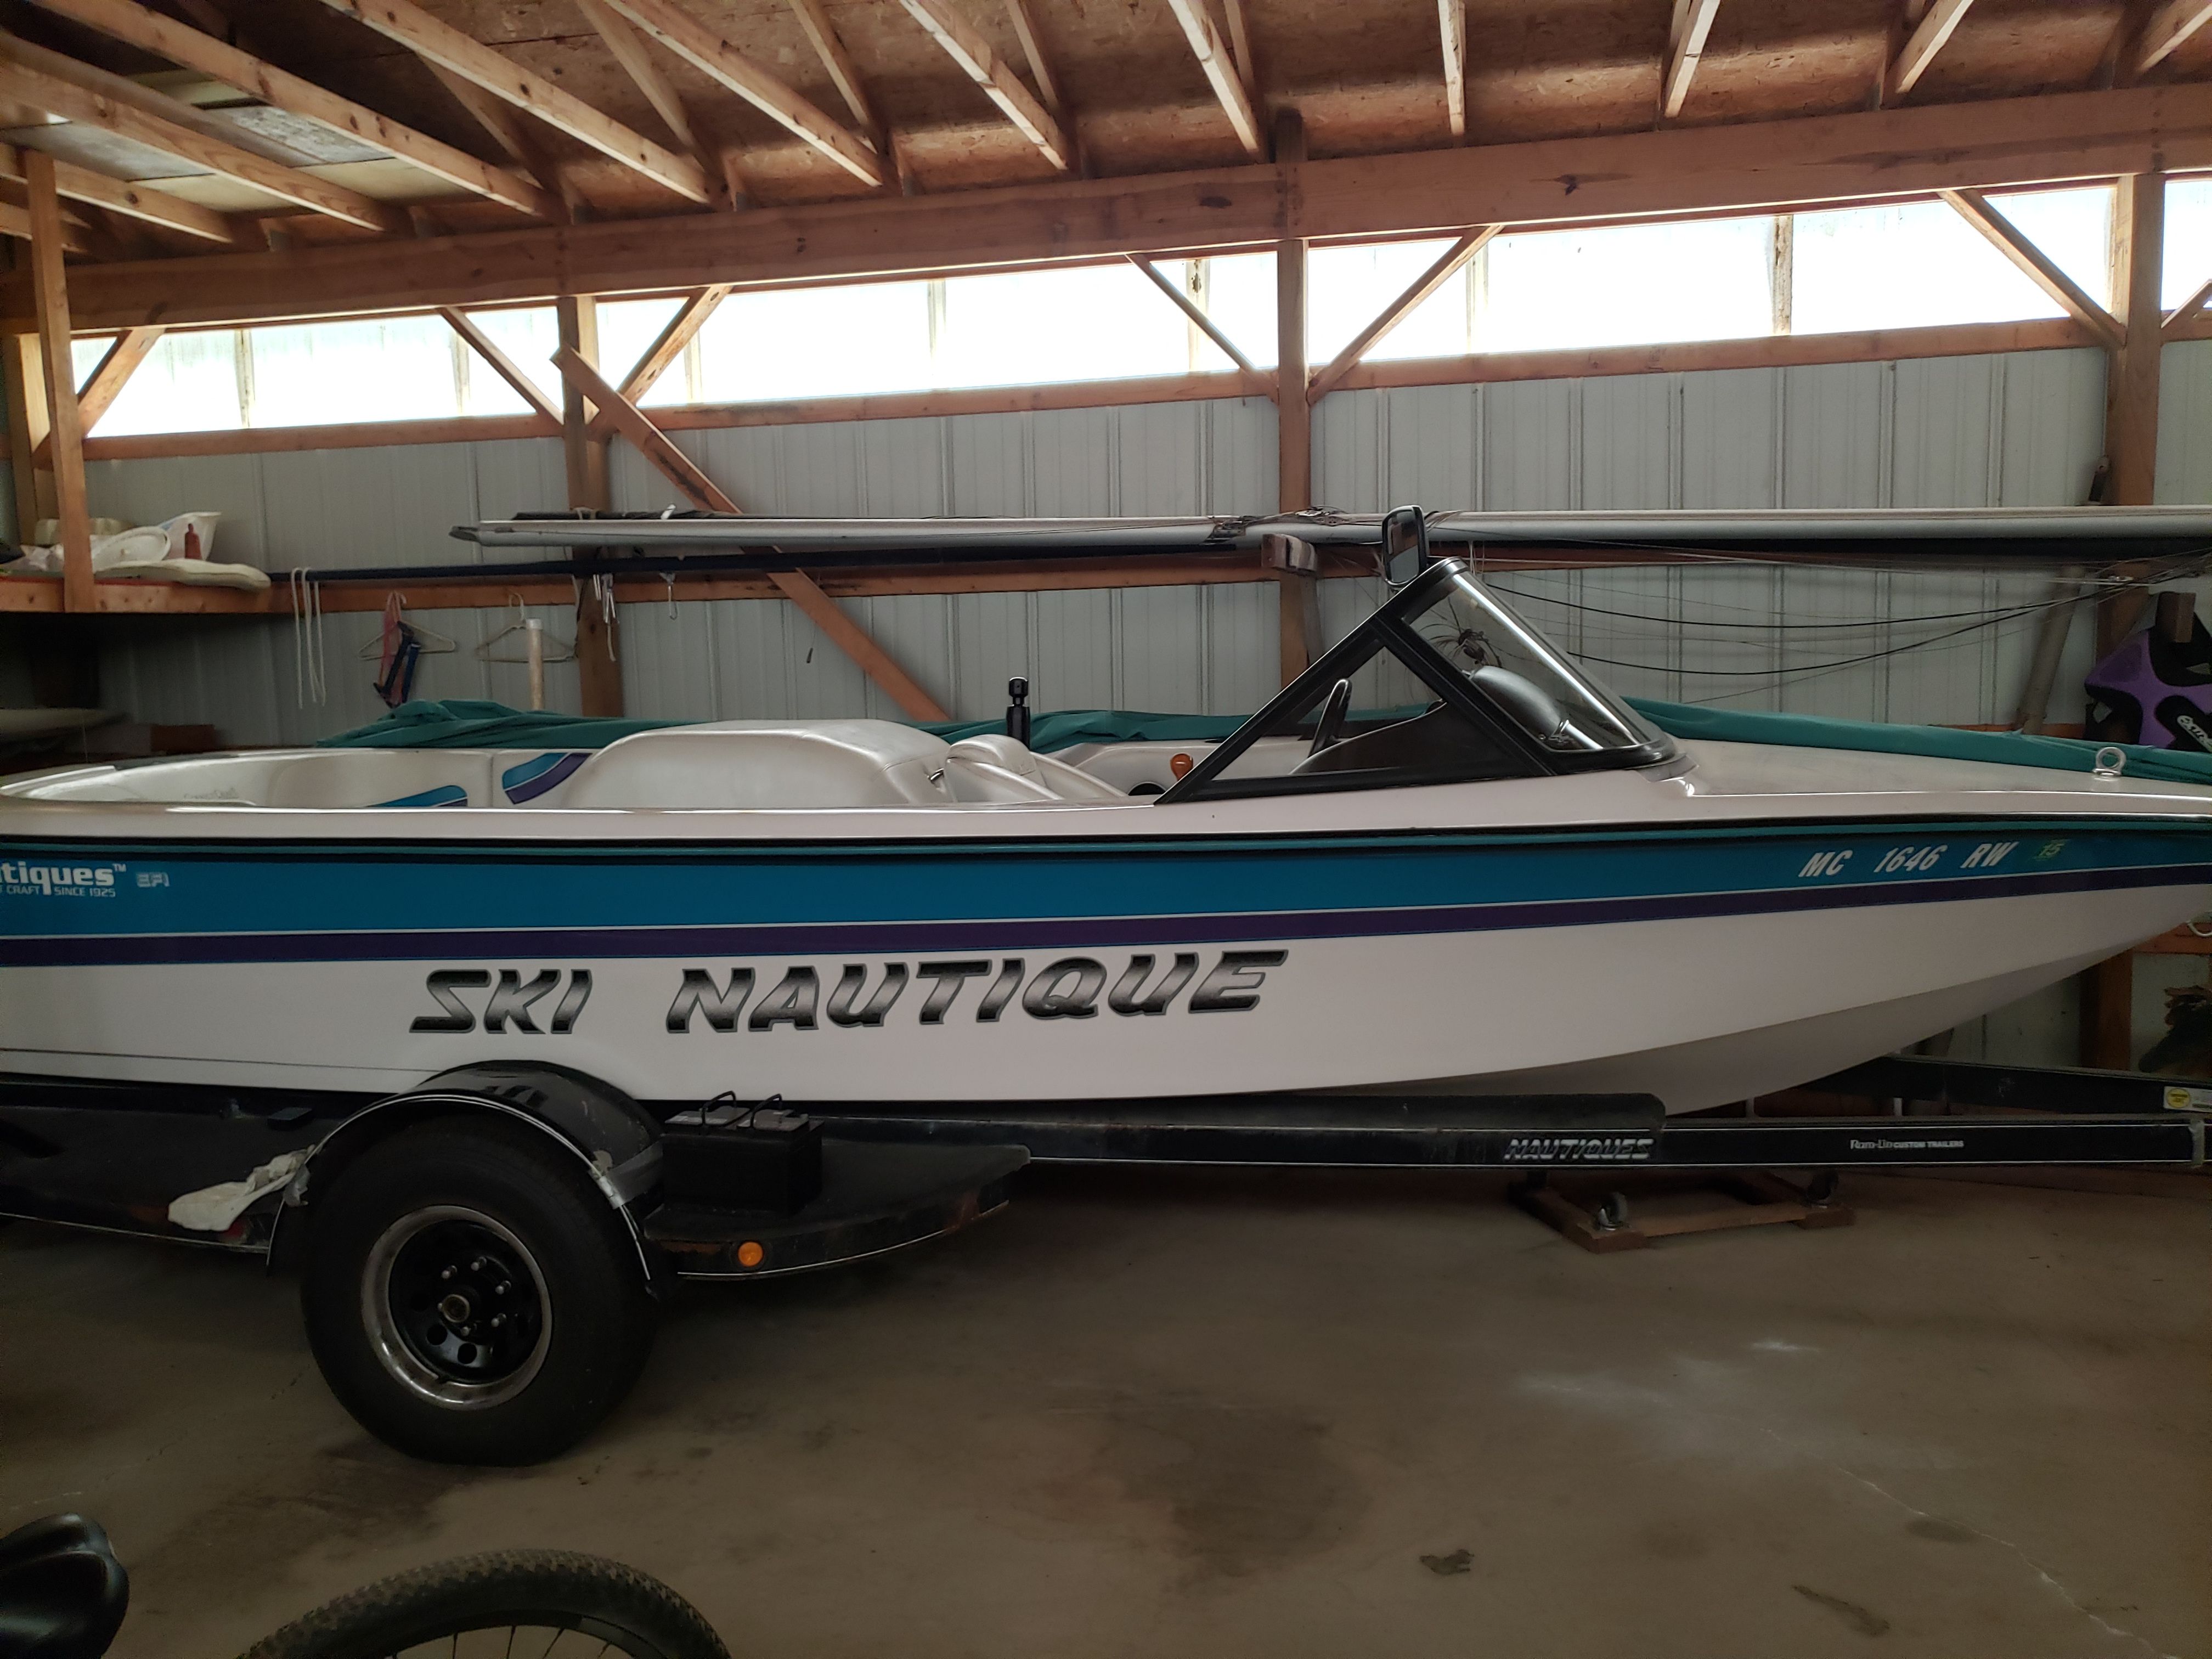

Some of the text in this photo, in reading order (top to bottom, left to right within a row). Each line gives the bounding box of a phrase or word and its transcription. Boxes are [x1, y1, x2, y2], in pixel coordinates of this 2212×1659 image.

[1798, 850, 1853, 877] MC
[1873, 845, 1948, 873] 1646
[1960, 841, 2019, 868] RW
[0, 861, 114, 895] tiques
[7, 885, 115, 898] CRAFT SINCE 1925
[409, 950, 1289, 1034] SKI NAUTIQUE
[1504, 1138, 1655, 1159] NAUTIQUES
